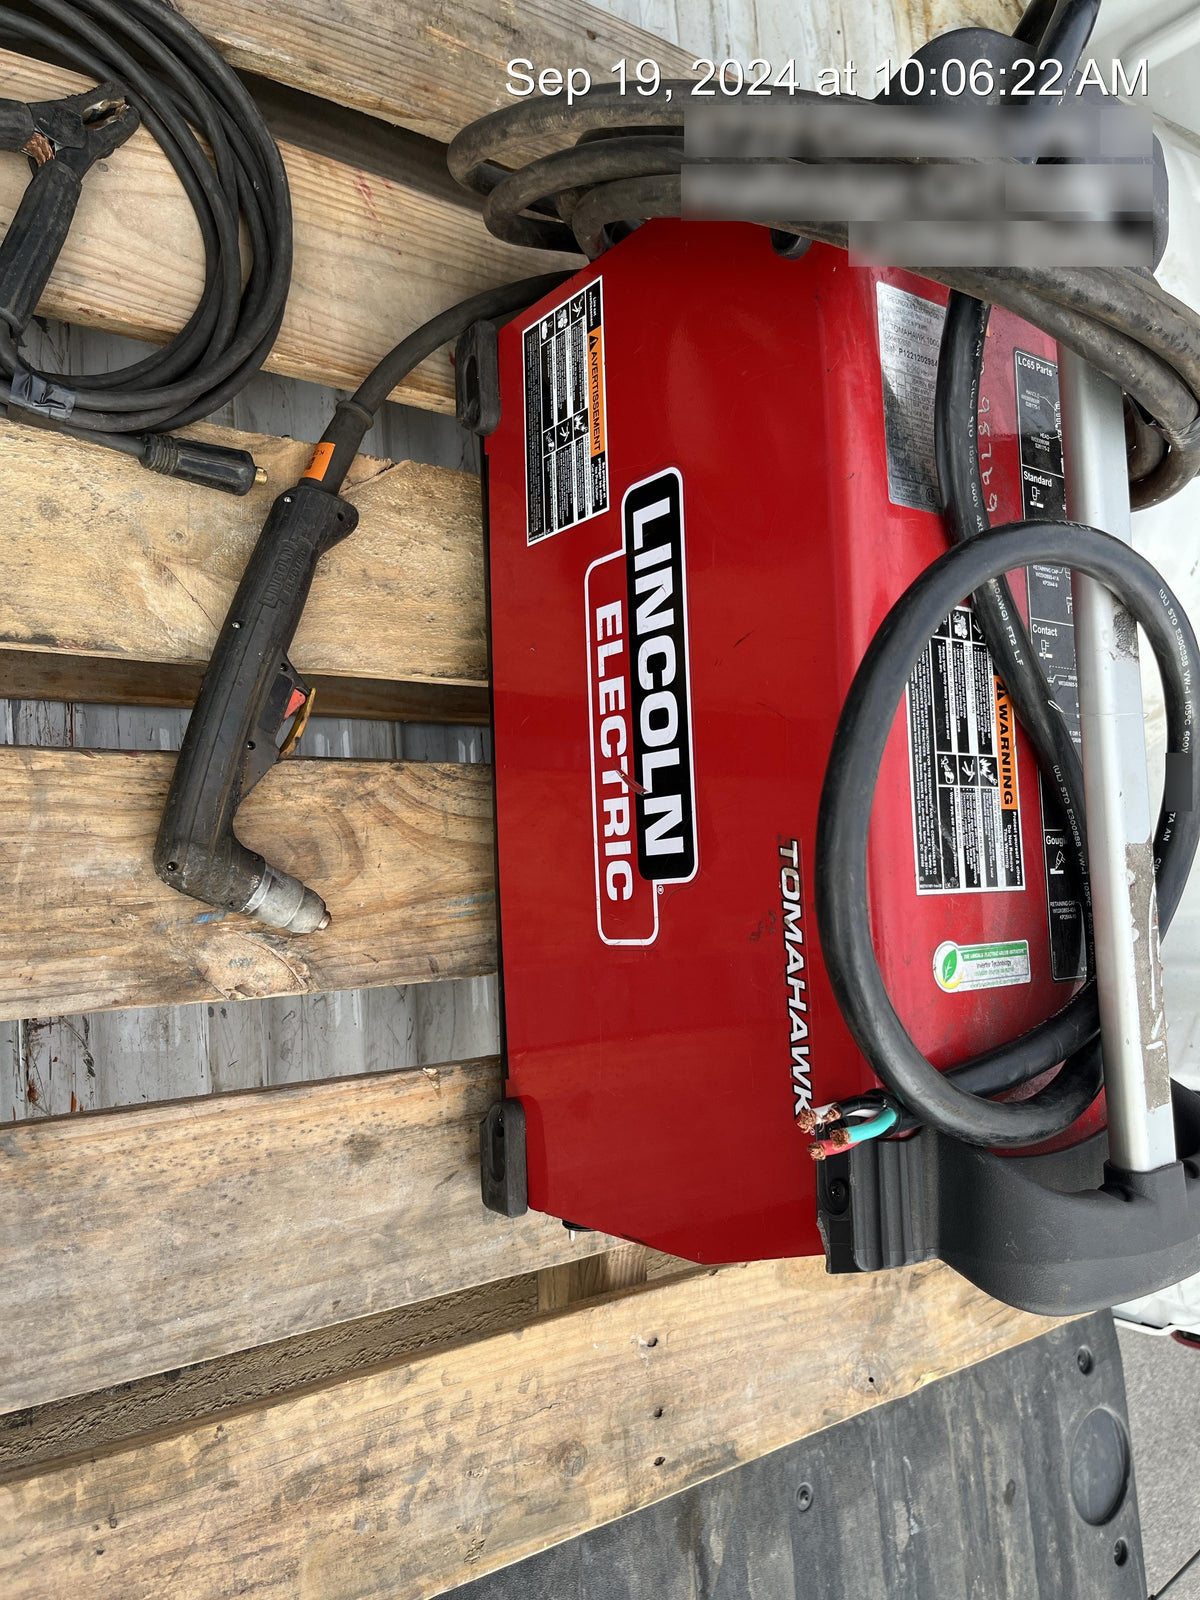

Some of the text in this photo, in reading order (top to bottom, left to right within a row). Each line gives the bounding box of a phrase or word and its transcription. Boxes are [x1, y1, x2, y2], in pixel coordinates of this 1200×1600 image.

[1017, 355, 1053, 377] LC65 Parts
[590, 348, 600, 453] AVERTISSEMENT
[1023, 470, 1052, 487] Standard
[1158, 588, 1170, 607] (UL)
[1167, 608, 1178, 626] STO
[1006, 625, 1017, 646] FT2
[1032, 623, 1058, 637] Contact
[632, 496, 685, 856] LINCOLN
[1183, 669, 1192, 695] VW-1
[595, 600, 633, 901] ELECTRIC
[1181, 729, 1190, 754] 600V
[997, 703, 1013, 805] WARNING
[1060, 786, 1070, 804] STO
[1046, 835, 1067, 848] Goug
[777, 838, 814, 1116] TOMAHAWK
